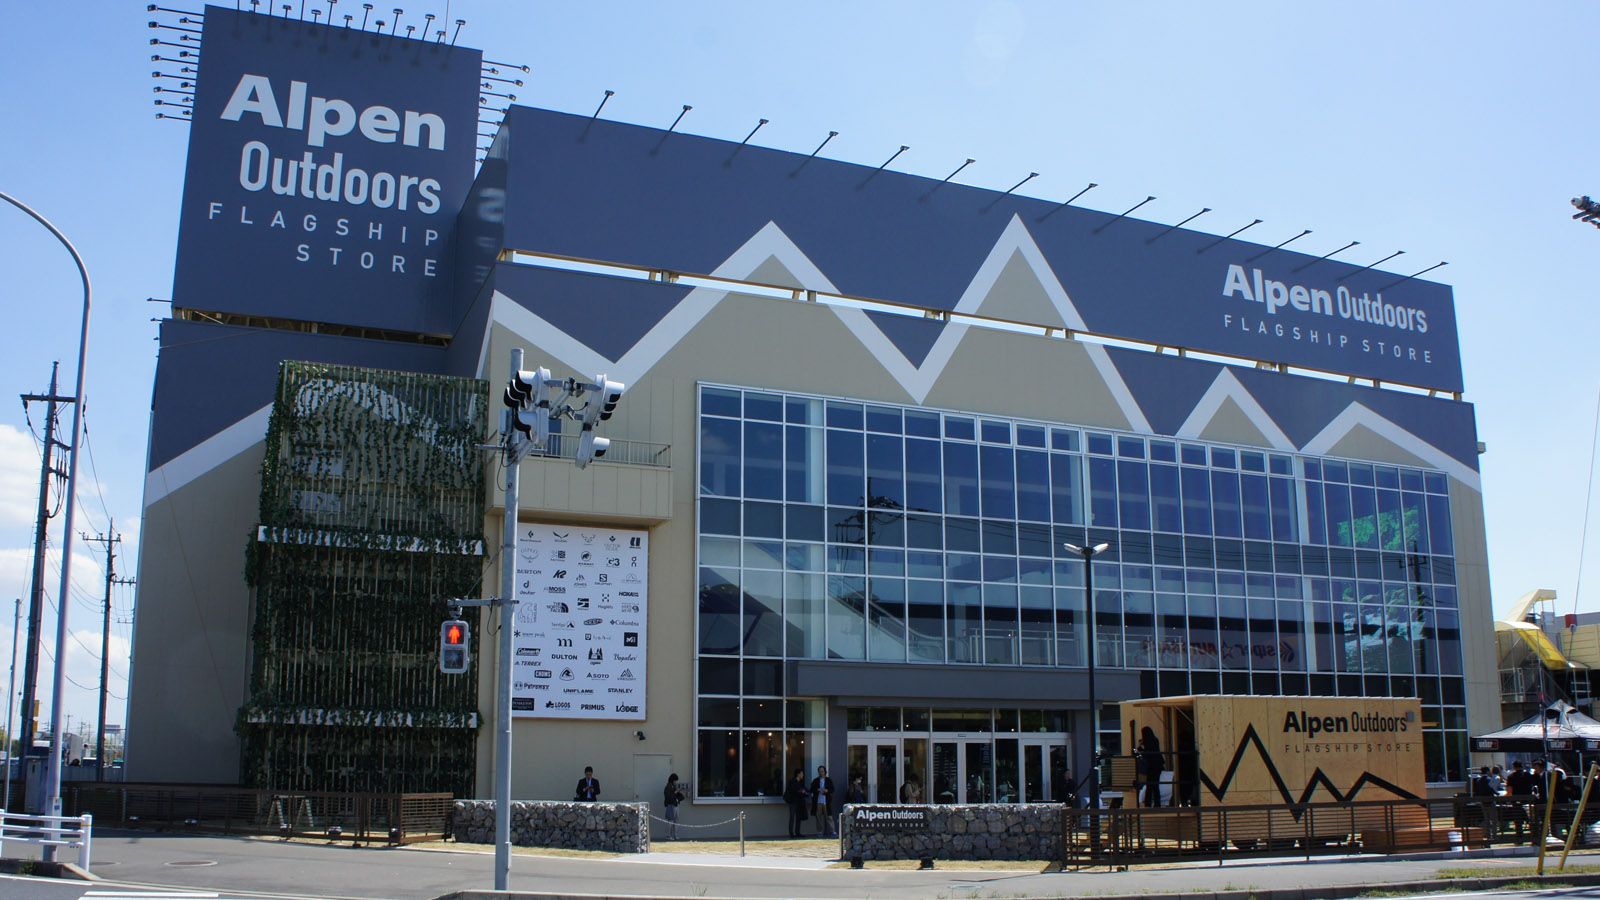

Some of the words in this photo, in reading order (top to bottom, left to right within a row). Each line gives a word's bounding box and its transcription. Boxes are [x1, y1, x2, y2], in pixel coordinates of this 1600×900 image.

[219, 73, 446, 151] Alpen
[239, 140, 441, 214] Outdoors
[208, 202, 438, 246] FLAGSHIP
[296, 244, 437, 277] STORE
[1222, 264, 1333, 315] Alpen
[1336, 286, 1428, 333] Outdoors
[1224, 314, 1348, 348] FLAGSHIP
[1362, 339, 1432, 364] STORE
[553, 569, 567, 579] K2
[554, 701, 571, 709] LOGOS
[580, 703, 605, 711] PRIMUS
[615, 704, 639, 712] LODGE
[1283, 711, 1348, 738] Alpen
[1351, 711, 1407, 732] Outdoors
[1285, 744, 1359, 753] FLAGSHIP
[1367, 743, 1411, 752] STORE
[856, 809, 891, 821] Alpen
[891, 809, 924, 820] Outdoors
